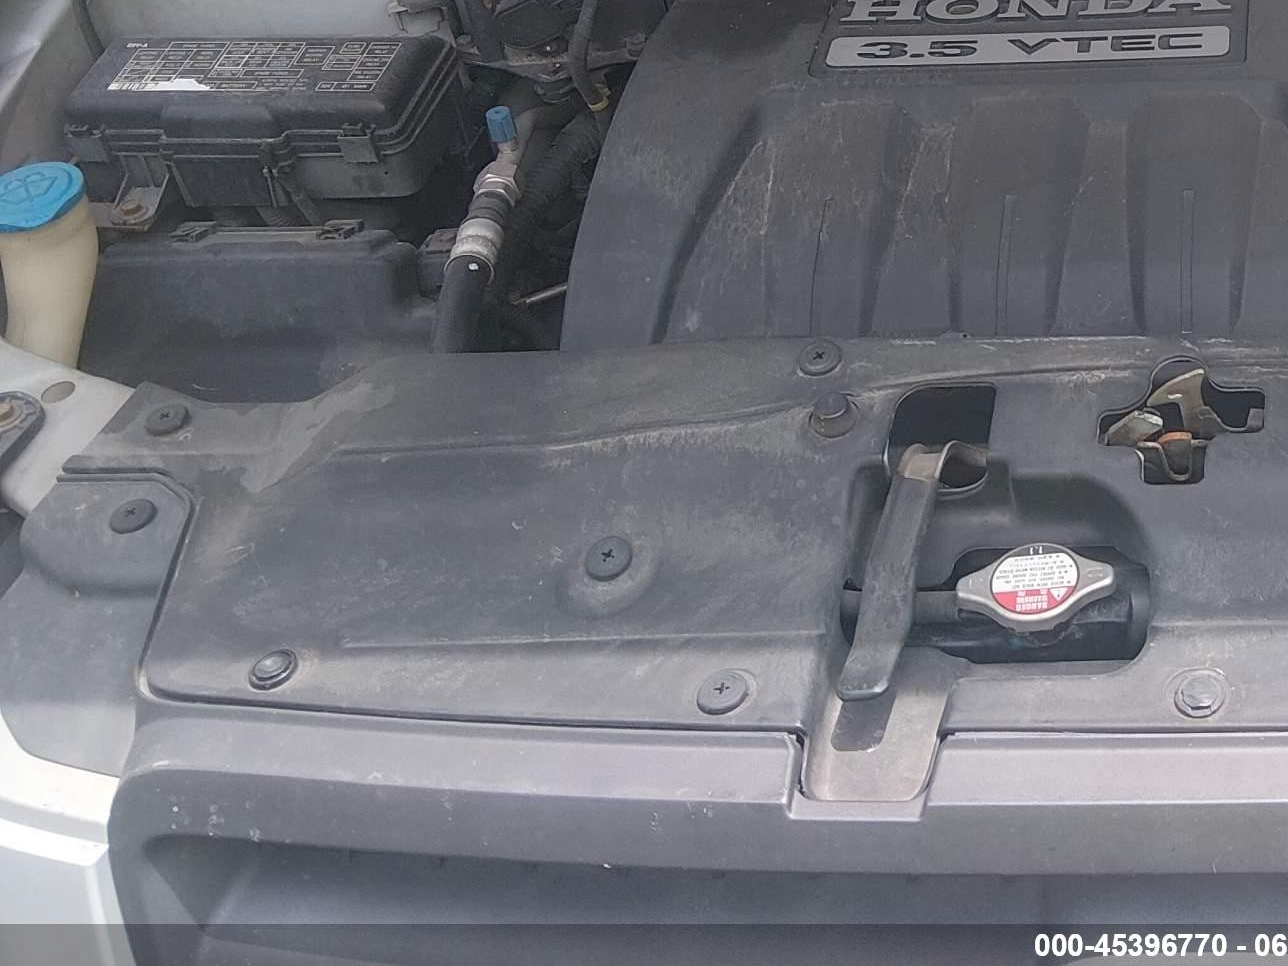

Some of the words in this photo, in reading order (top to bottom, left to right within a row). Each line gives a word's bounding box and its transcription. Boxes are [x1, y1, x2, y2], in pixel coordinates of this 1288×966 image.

[856, 40, 978, 60] 3.5
[1007, 33, 1204, 56] VTEC
[1016, 602, 1047, 611] DANGER
